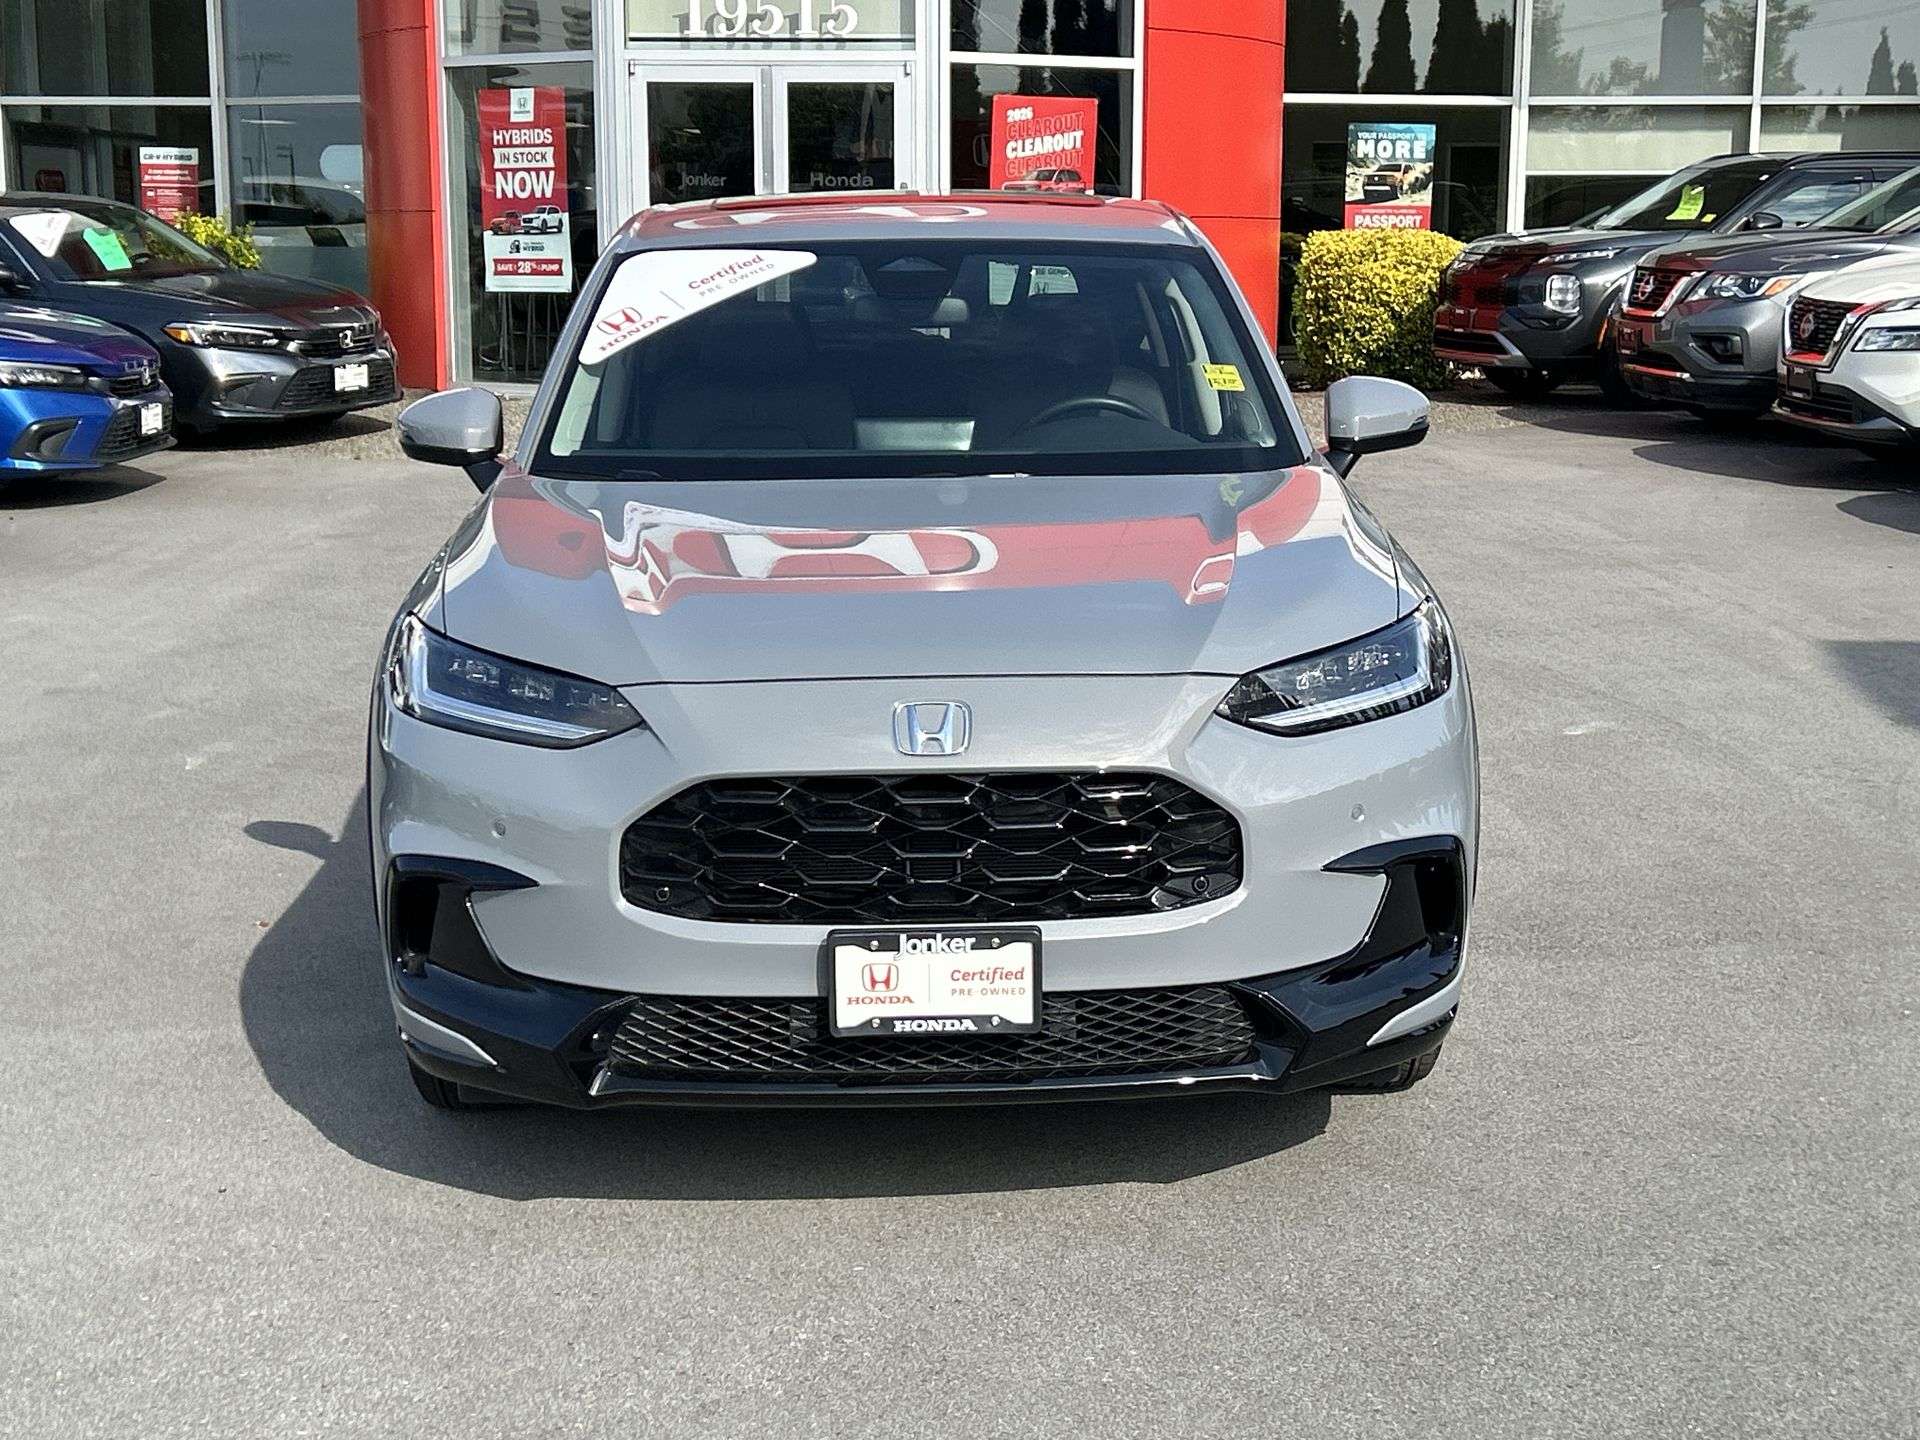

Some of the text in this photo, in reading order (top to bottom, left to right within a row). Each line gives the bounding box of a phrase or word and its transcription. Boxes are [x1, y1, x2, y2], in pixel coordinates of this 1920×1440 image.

[684, 0, 858, 36] 19515
[1007, 112, 1084, 139] CLEAROUT
[493, 128, 552, 145] HYBRIDS
[1006, 130, 1084, 159] CLEAROUT
[500, 151, 547, 163] IN STOCK
[1357, 140, 1426, 159] MORE
[495, 170, 555, 199] NOW
[810, 172, 874, 188] Honda
[1354, 214, 1423, 228] PASSPORT
[688, 254, 765, 290] Certified
[599, 314, 669, 352] HONDA
[950, 966, 1025, 985] Certified
[847, 995, 915, 1006] HONDA
[893, 1018, 978, 1032] HONDA
